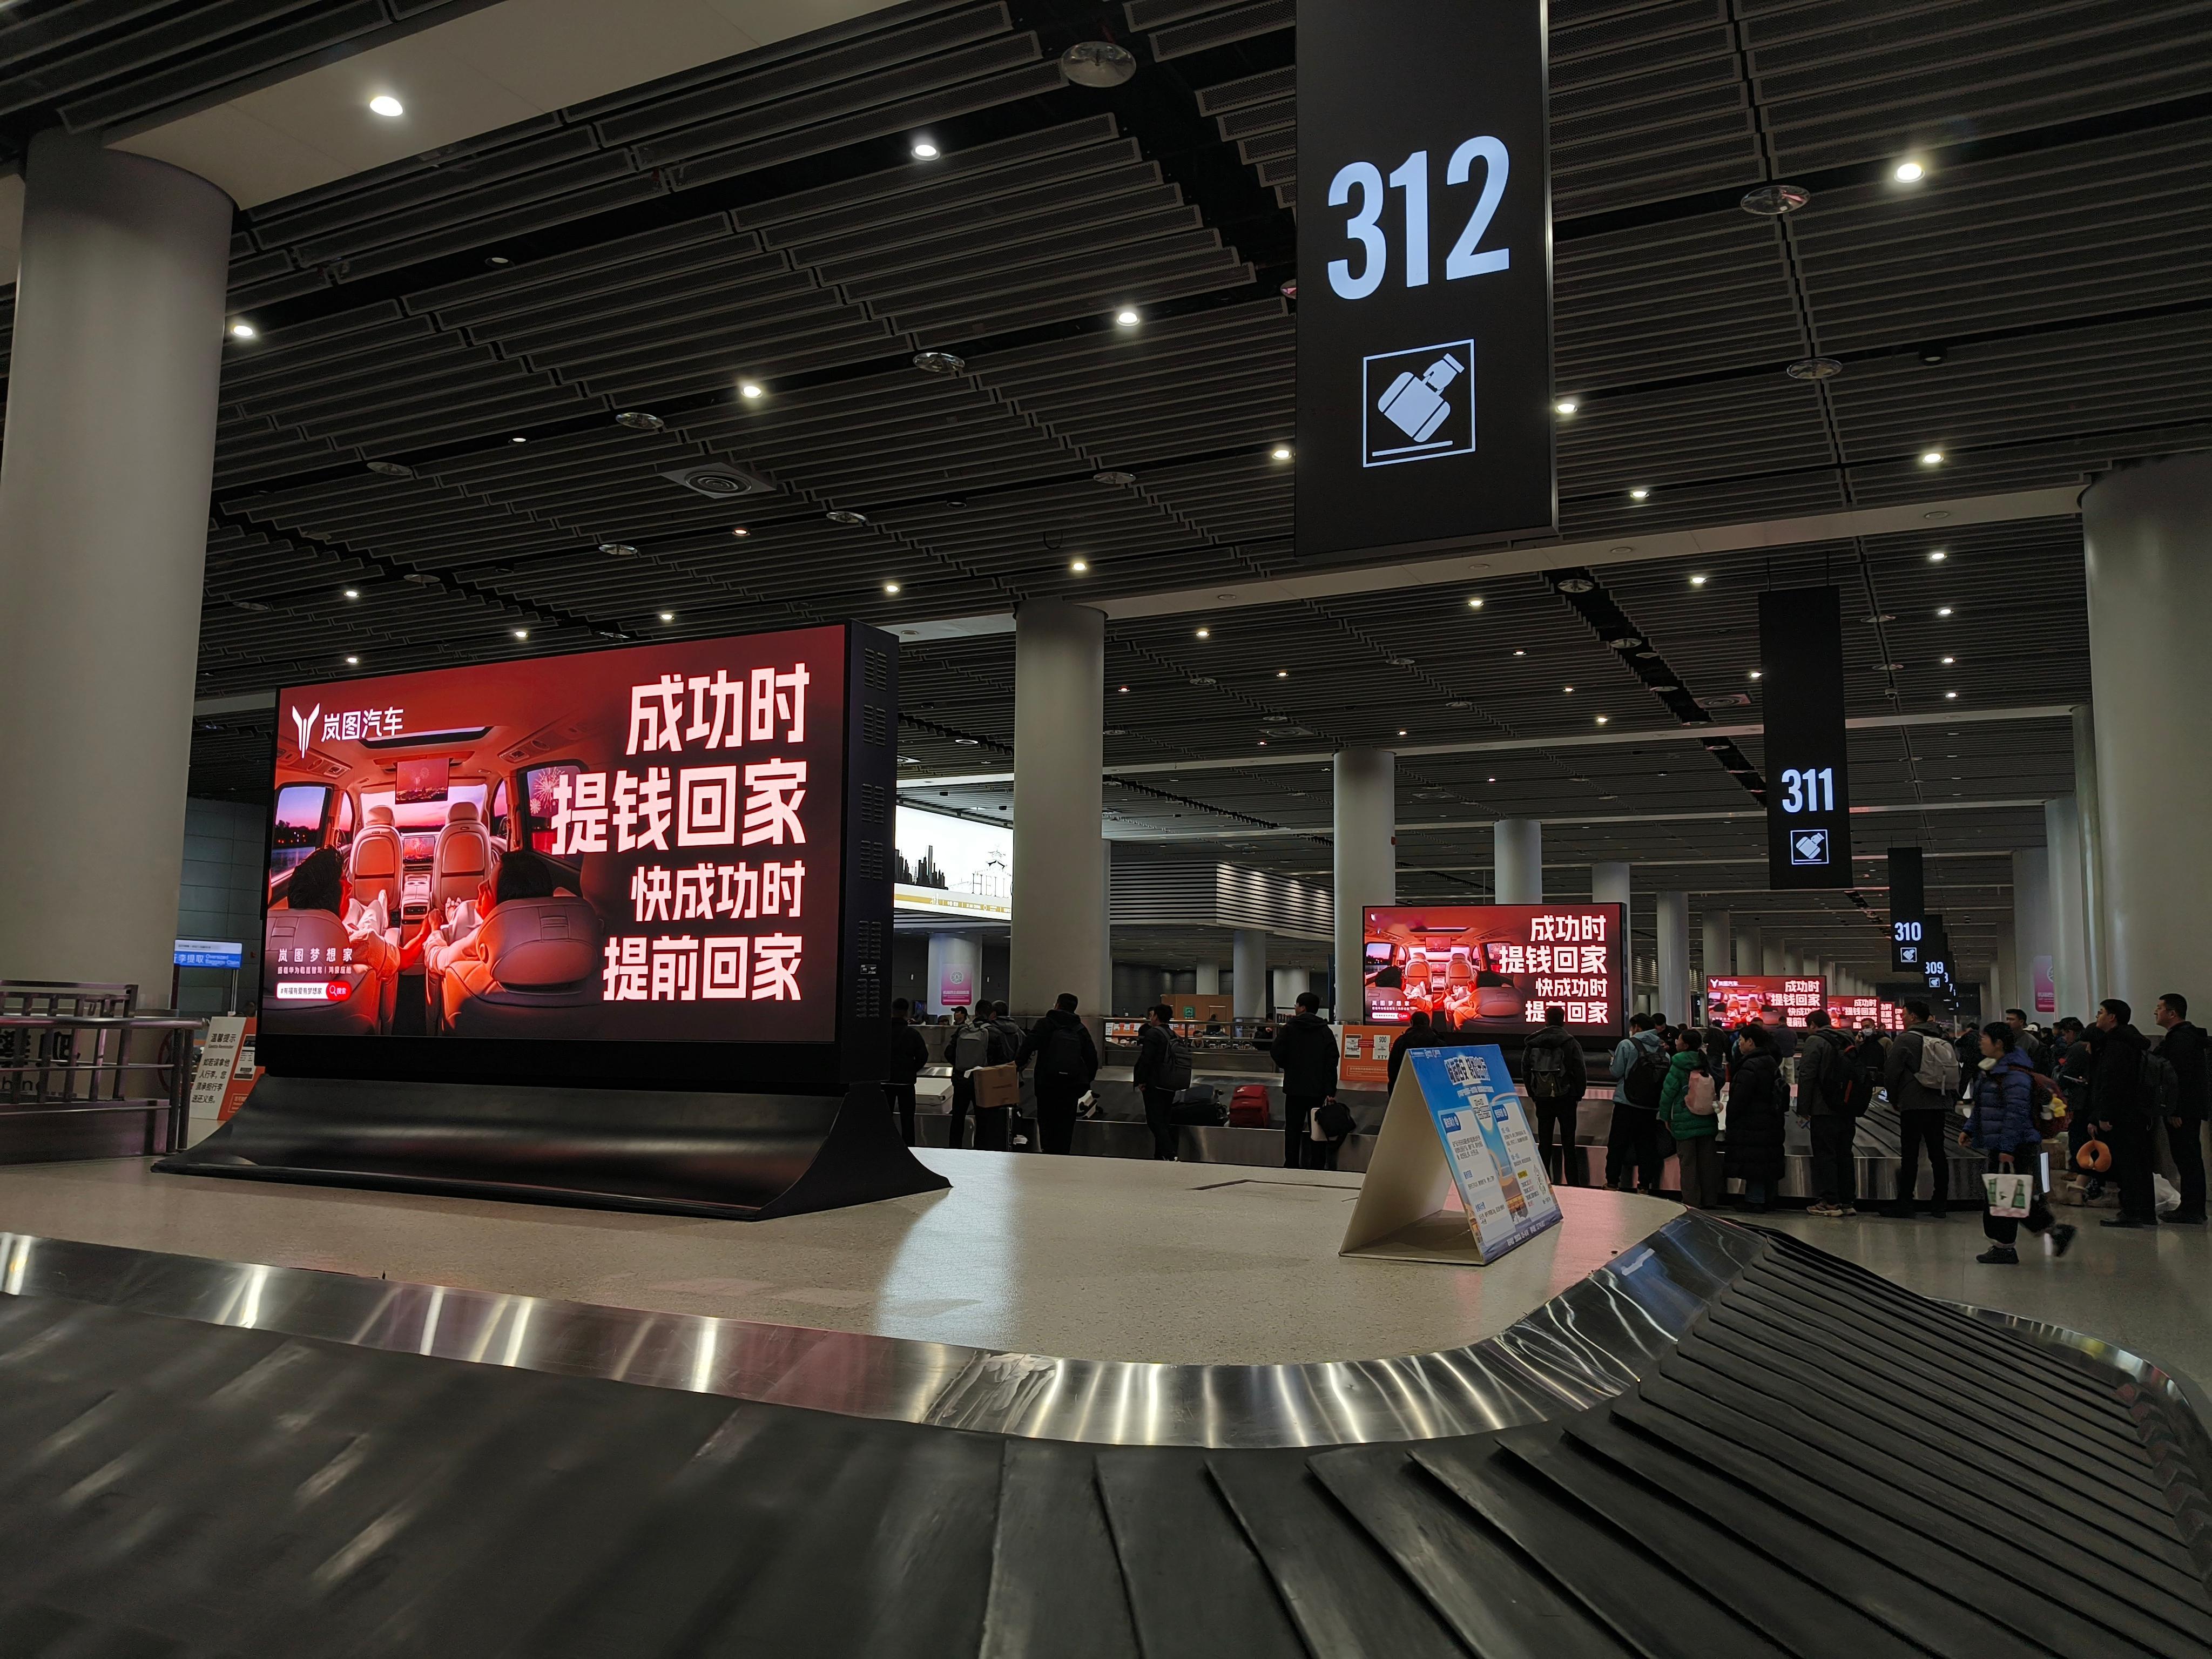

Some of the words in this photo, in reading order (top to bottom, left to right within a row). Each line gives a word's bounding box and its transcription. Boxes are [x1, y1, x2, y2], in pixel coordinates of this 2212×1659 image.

[1328, 136, 1509, 300] 312
[625, 663, 810, 755] 成功时
[321, 706, 404, 742] 岚图汽车
[1782, 768, 1833, 812] 311
[551, 758, 806, 855] 提钱回家
[631, 860, 805, 921] 快成功时
[1530, 915, 1607, 941] 成功时
[1894, 922, 1921, 941] 310
[278, 948, 353, 962] 岚图梦想家
[603, 932, 802, 1000] 提前回家
[1499, 945, 1608, 974] 提钱回家
[1925, 962, 1944, 974] 309
[1535, 977, 1608, 997] 快成功时
[1785, 980, 1820, 992] 成功时
[1771, 993, 1820, 1006] 提钱回家
[1788, 1007, 1820, 1016] 快成功
[211, 1033, 237, 1043] 温馨提示
